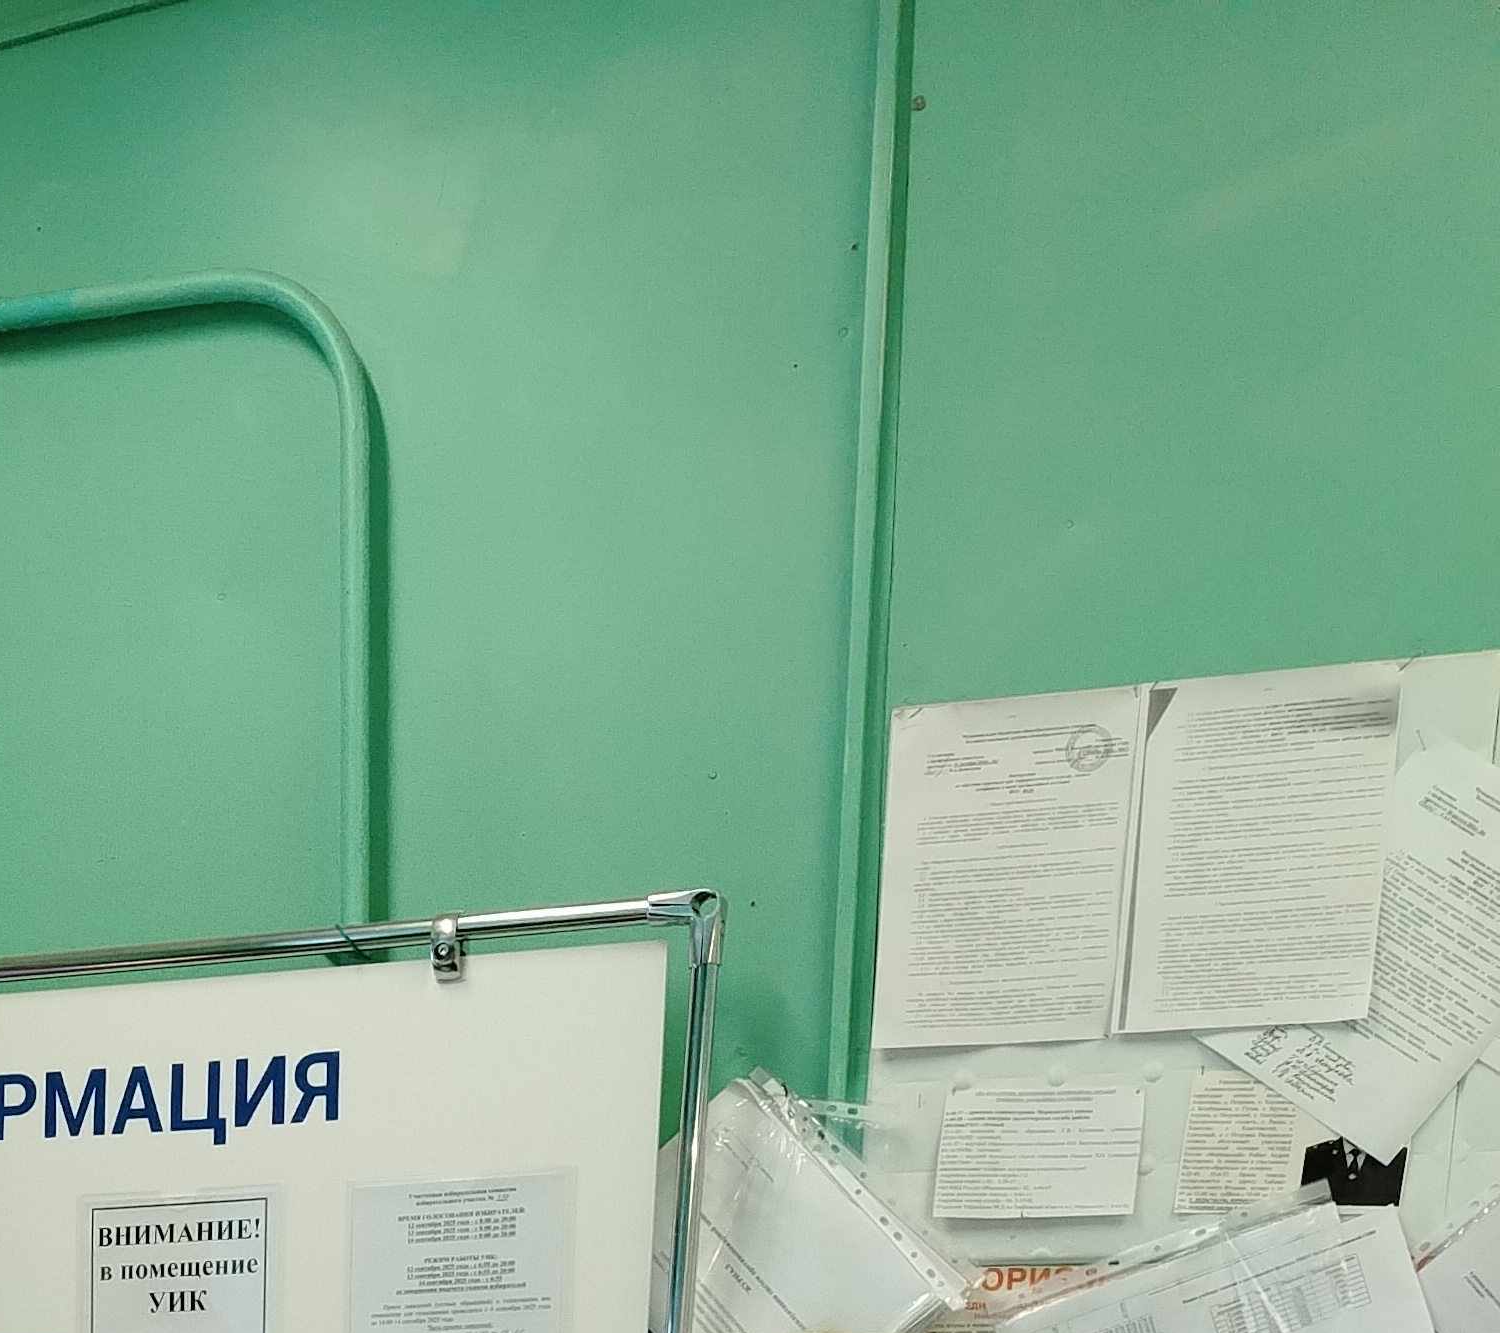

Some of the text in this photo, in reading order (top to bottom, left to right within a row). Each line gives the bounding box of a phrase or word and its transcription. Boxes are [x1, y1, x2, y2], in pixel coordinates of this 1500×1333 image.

[98, 1218, 261, 1248] ВНИМАНИЕ!
[100, 1258, 260, 1281] в помещение
[148, 1290, 208, 1314] УИК
